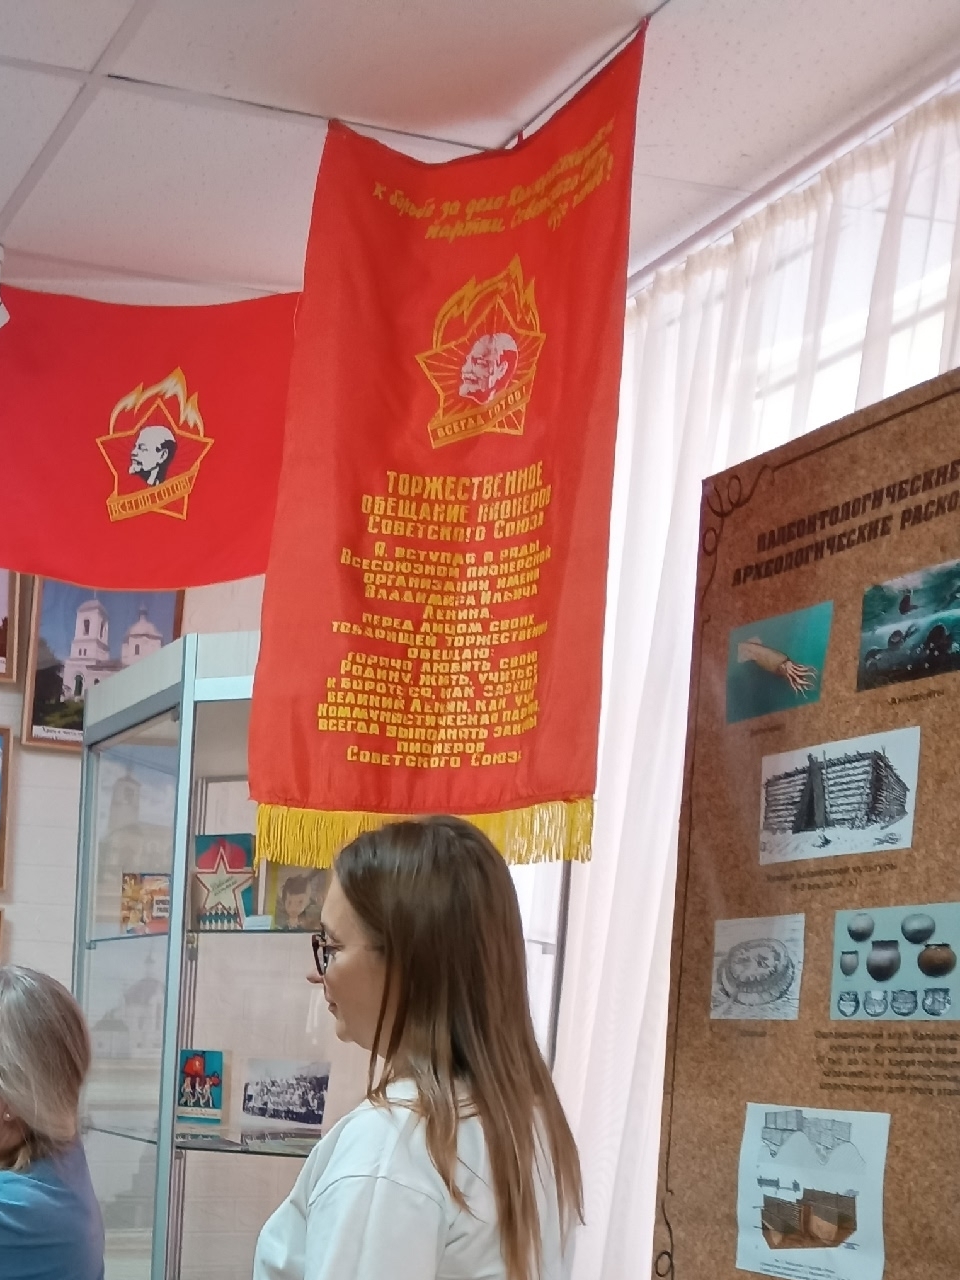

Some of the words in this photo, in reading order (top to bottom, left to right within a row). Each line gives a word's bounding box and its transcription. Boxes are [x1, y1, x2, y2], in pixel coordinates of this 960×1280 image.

[387, 460, 543, 501] ТОРЖЕСТВЕННОЕ
[361, 494, 470, 523] ОБЕЩАНИЕ
[477, 484, 552, 523] ПИОНЕРОВ
[732, 515, 893, 587] АРХЕОЛОГИЧЕСКИЕ
[363, 572, 490, 593] ОРГАНИЗАЦИИ
[496, 568, 540, 590] ИМЕНИ
[362, 612, 415, 631] ПЕРЕД
[420, 621, 483, 636] ЛИЦОМ
[489, 613, 535, 632] СВОИХ
[499, 651, 538, 669] СВОЮ
[318, 718, 380, 736] ВСЕГДА
[396, 741, 486, 755] ПИОНЕРОВ
